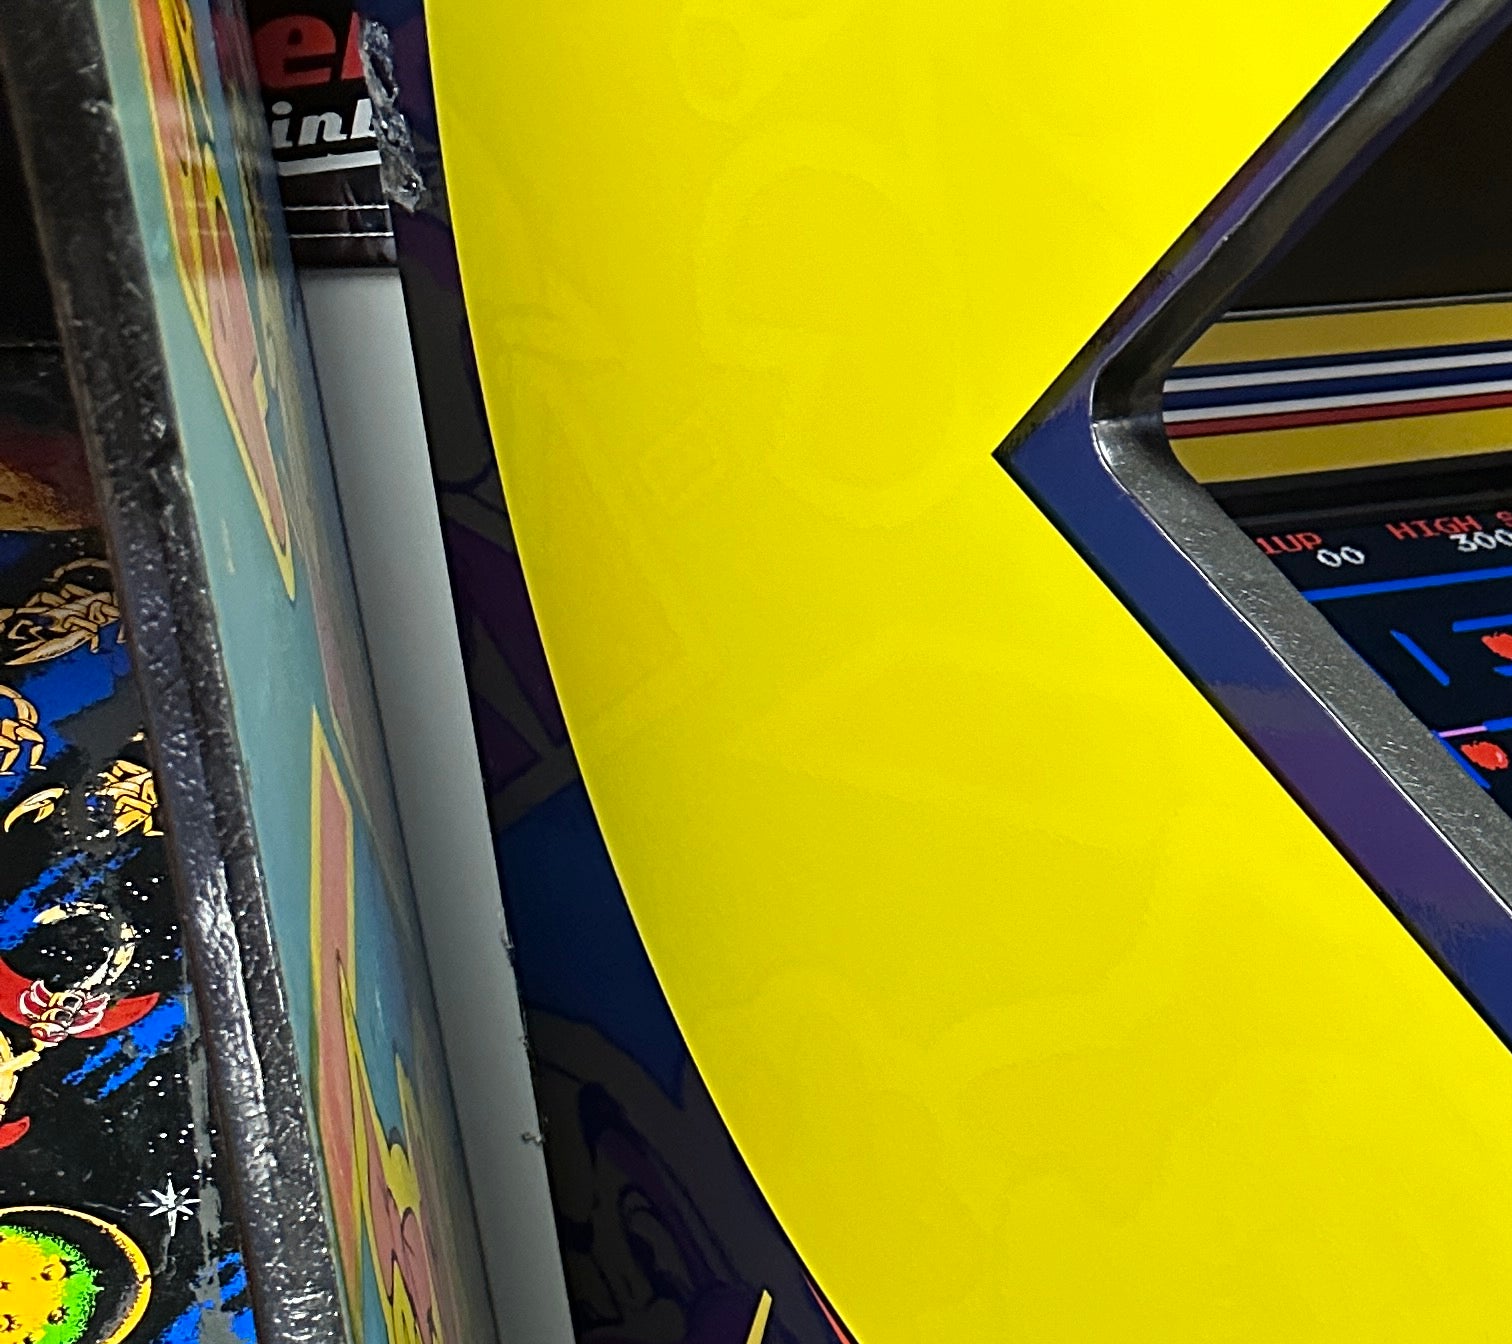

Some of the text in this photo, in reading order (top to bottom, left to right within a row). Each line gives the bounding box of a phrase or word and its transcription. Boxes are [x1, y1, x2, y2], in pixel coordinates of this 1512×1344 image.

[1385, 514, 1483, 541] HIGH
[1255, 530, 1323, 555] 1UP
[1316, 545, 1366, 568] 00
